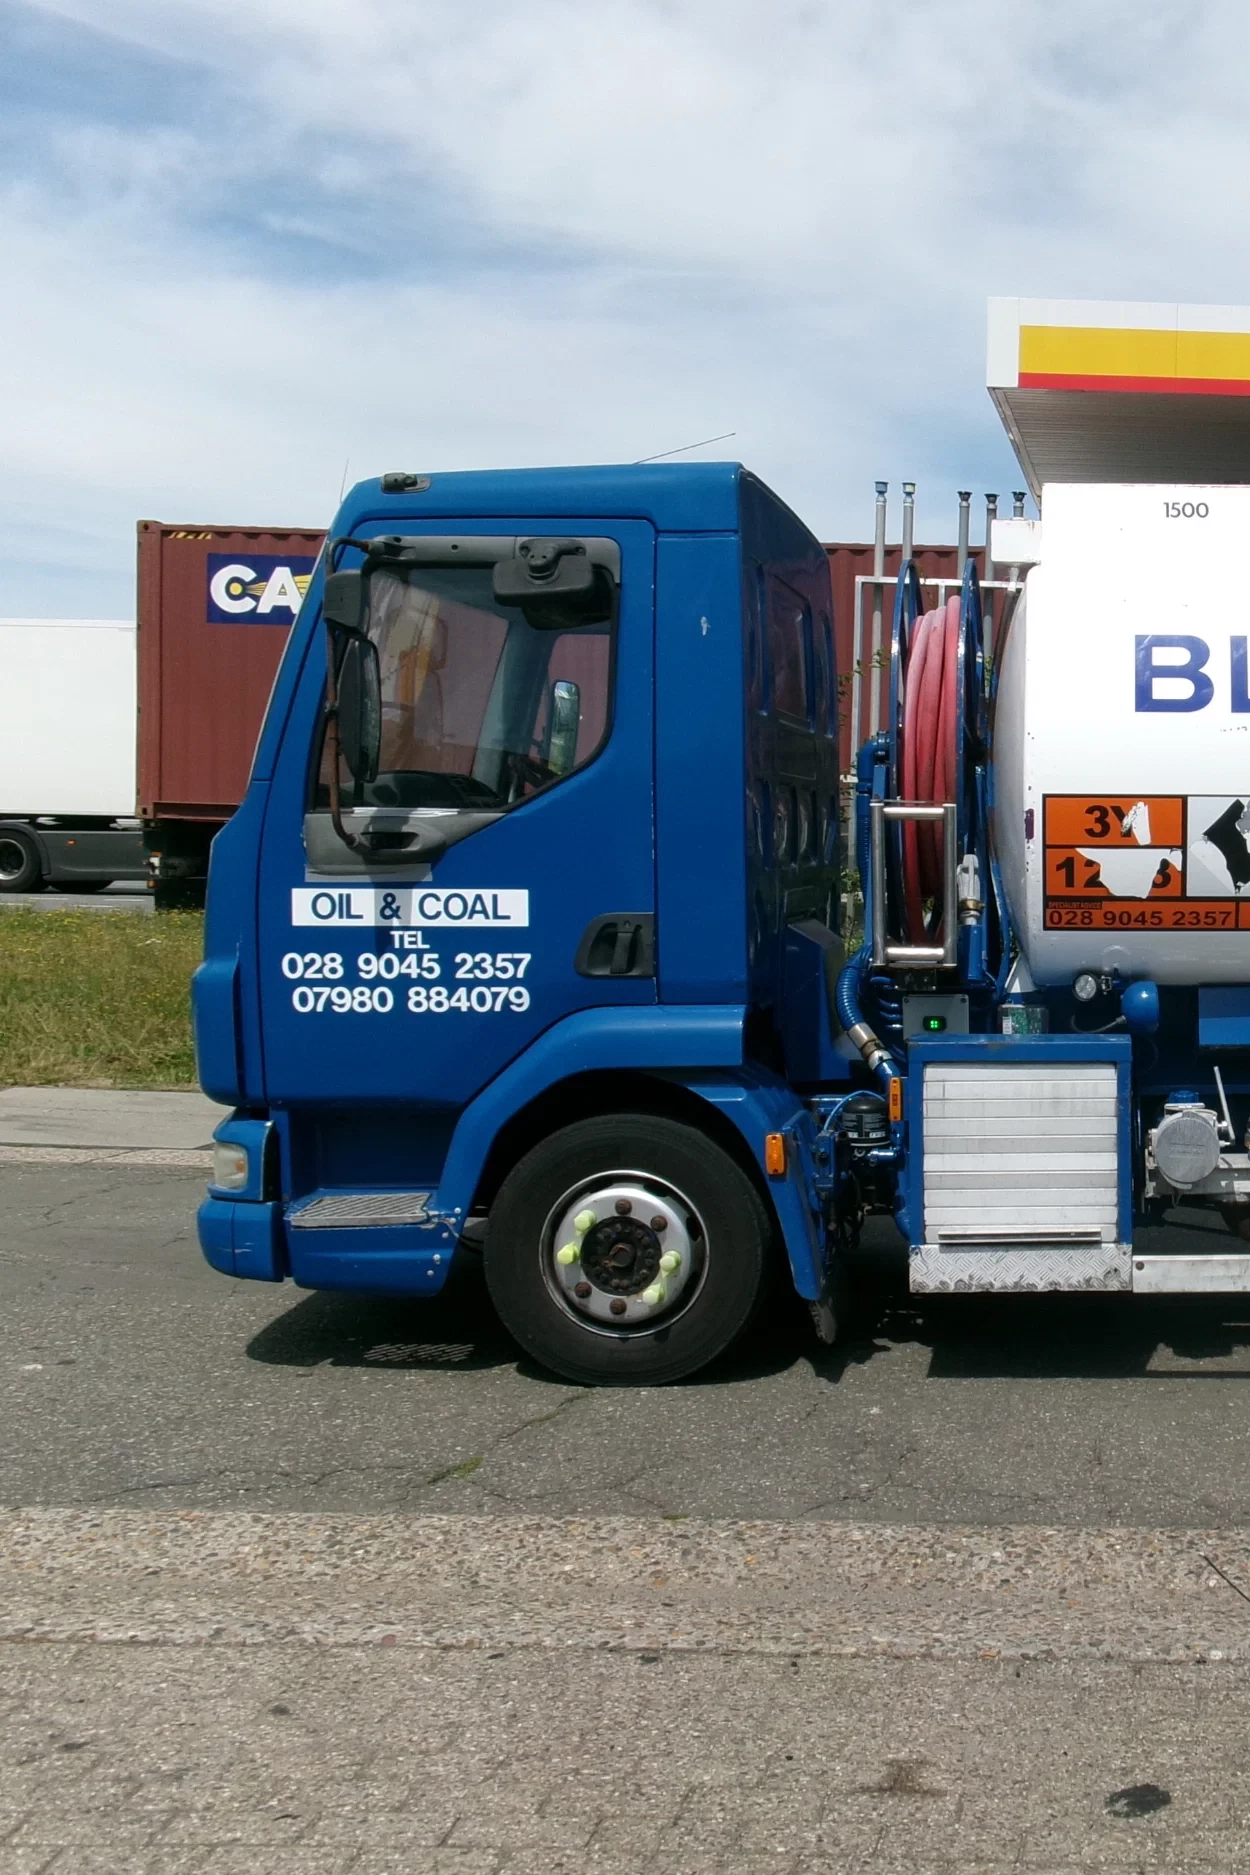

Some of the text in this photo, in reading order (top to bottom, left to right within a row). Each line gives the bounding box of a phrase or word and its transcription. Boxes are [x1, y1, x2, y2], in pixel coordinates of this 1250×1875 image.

[1163, 502, 1209, 519] 1500
[1056, 857, 1172, 888] 123
[311, 892, 511, 921] OIL & COAL
[1049, 910, 1232, 926] 028 9045 2357
[390, 930, 431, 949] TEL
[281, 952, 532, 980] 028 9045 2357
[292, 986, 530, 1013] 07980 884079
